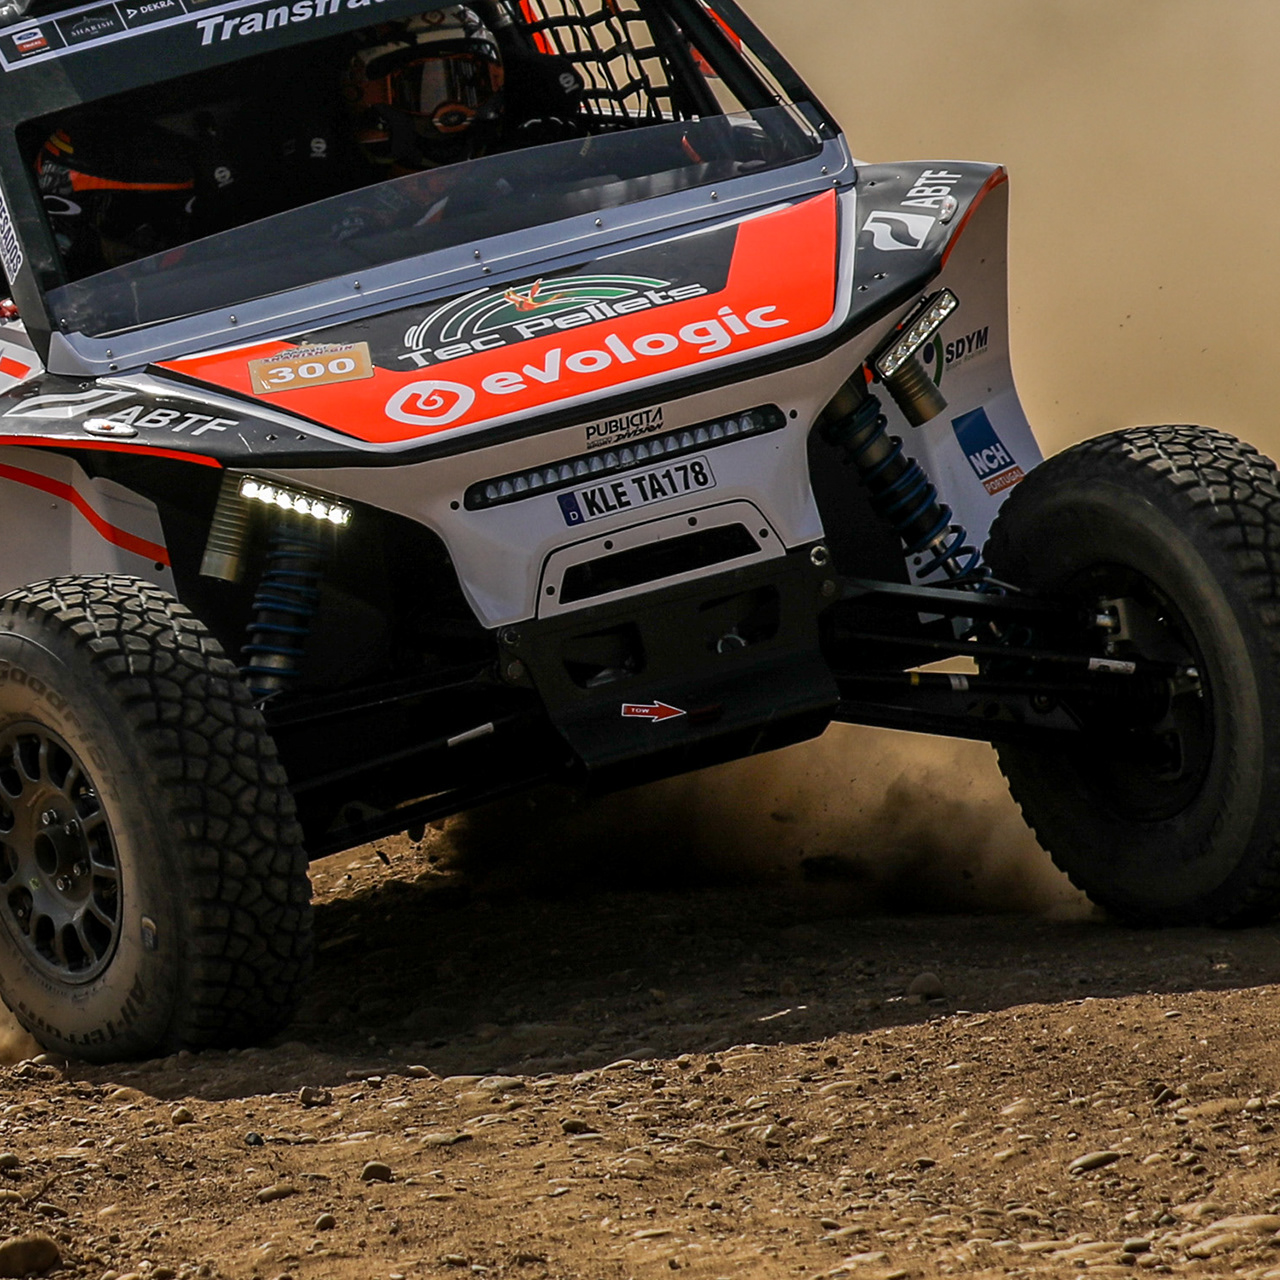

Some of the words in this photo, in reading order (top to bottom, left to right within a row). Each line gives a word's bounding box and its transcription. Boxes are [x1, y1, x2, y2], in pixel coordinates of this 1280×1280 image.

[140, 0, 175, 14] DEKRA
[71, 19, 114, 37] SHARISH
[900, 169, 963, 209] ABTF
[397, 333, 506, 368] Tec
[513, 283, 709, 339] Pellets
[945, 326, 989, 364] SDYM
[267, 357, 356, 384] 300
[107, 405, 240, 436] ABTF
[586, 407, 663, 440] PUBLICITA
[969, 443, 1011, 476] NCH
[582, 482, 632, 517] KLE
[631, 461, 709, 502] TA178
[984, 469, 1025, 495] PORTUGAL
[570, 511, 579, 521] D
